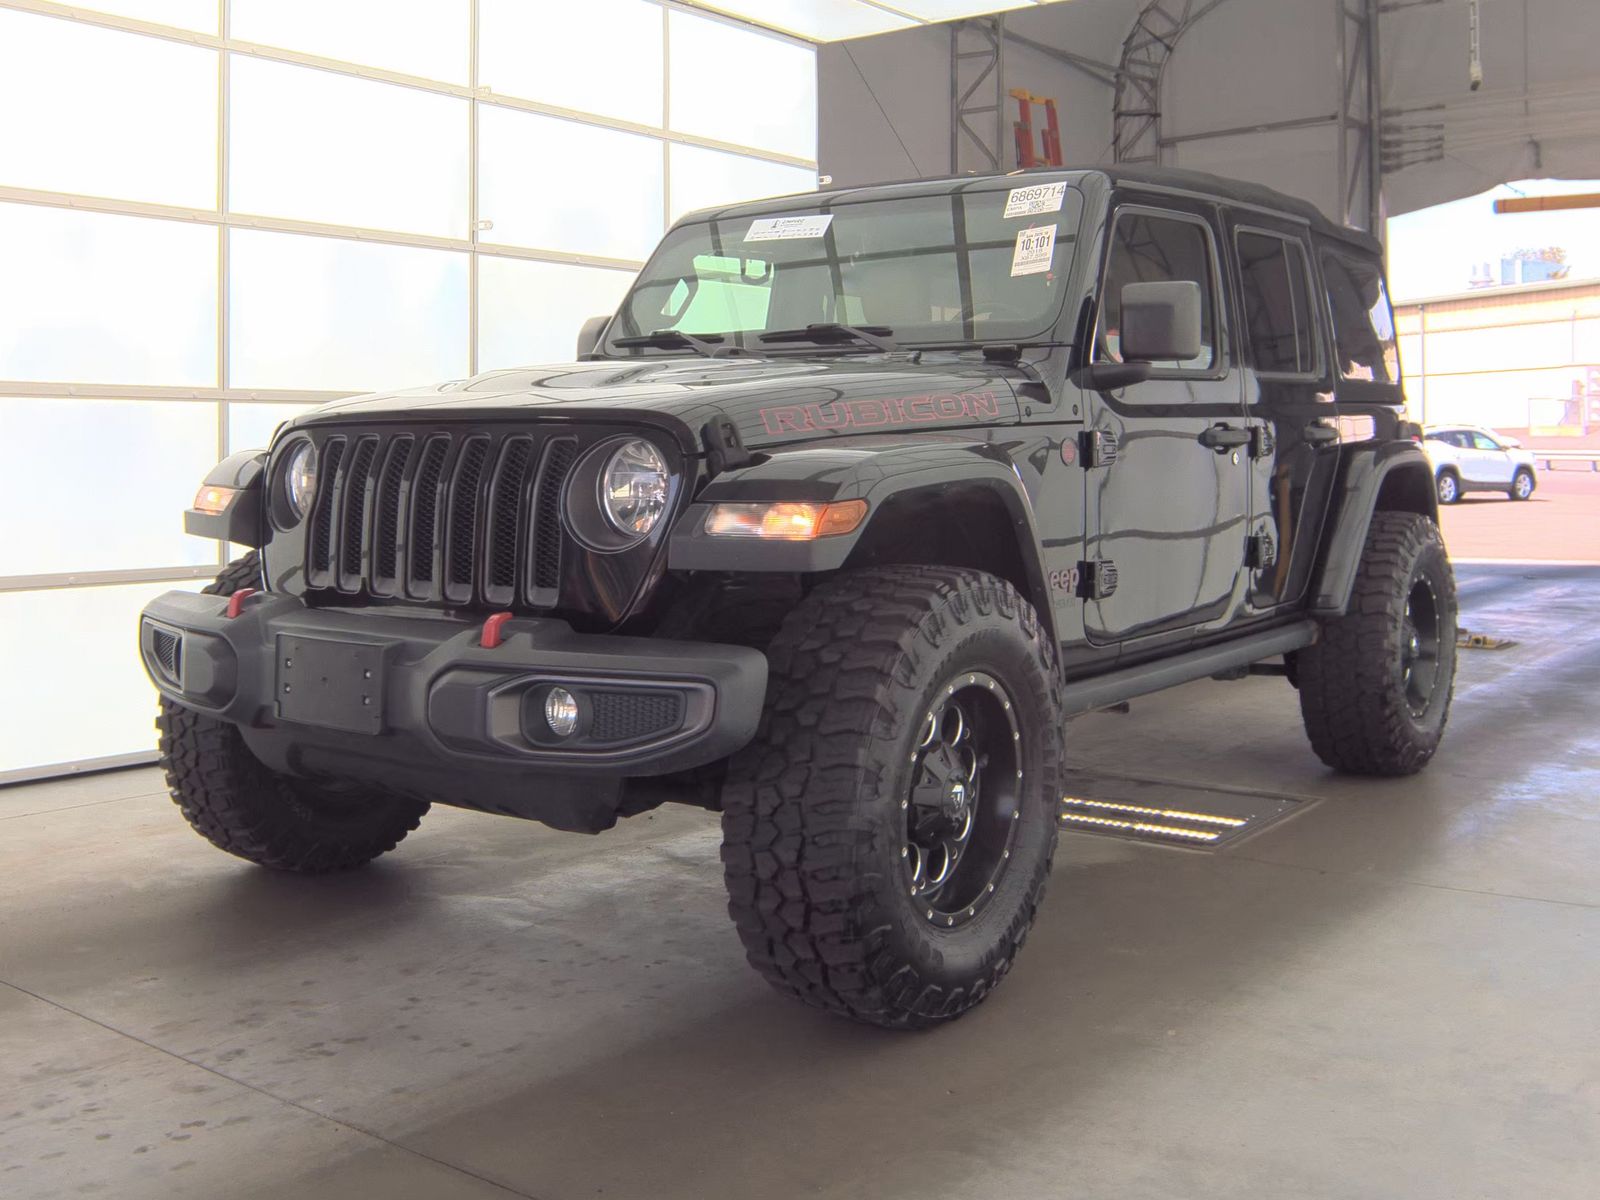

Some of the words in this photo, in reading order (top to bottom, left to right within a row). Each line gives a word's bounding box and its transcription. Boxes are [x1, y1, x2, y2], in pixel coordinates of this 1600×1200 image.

[1010, 184, 1065, 203] 6869714
[1021, 235, 1051, 251] 10:101
[760, 392, 999, 435] RUBICON
[1049, 568, 1080, 593] eep
